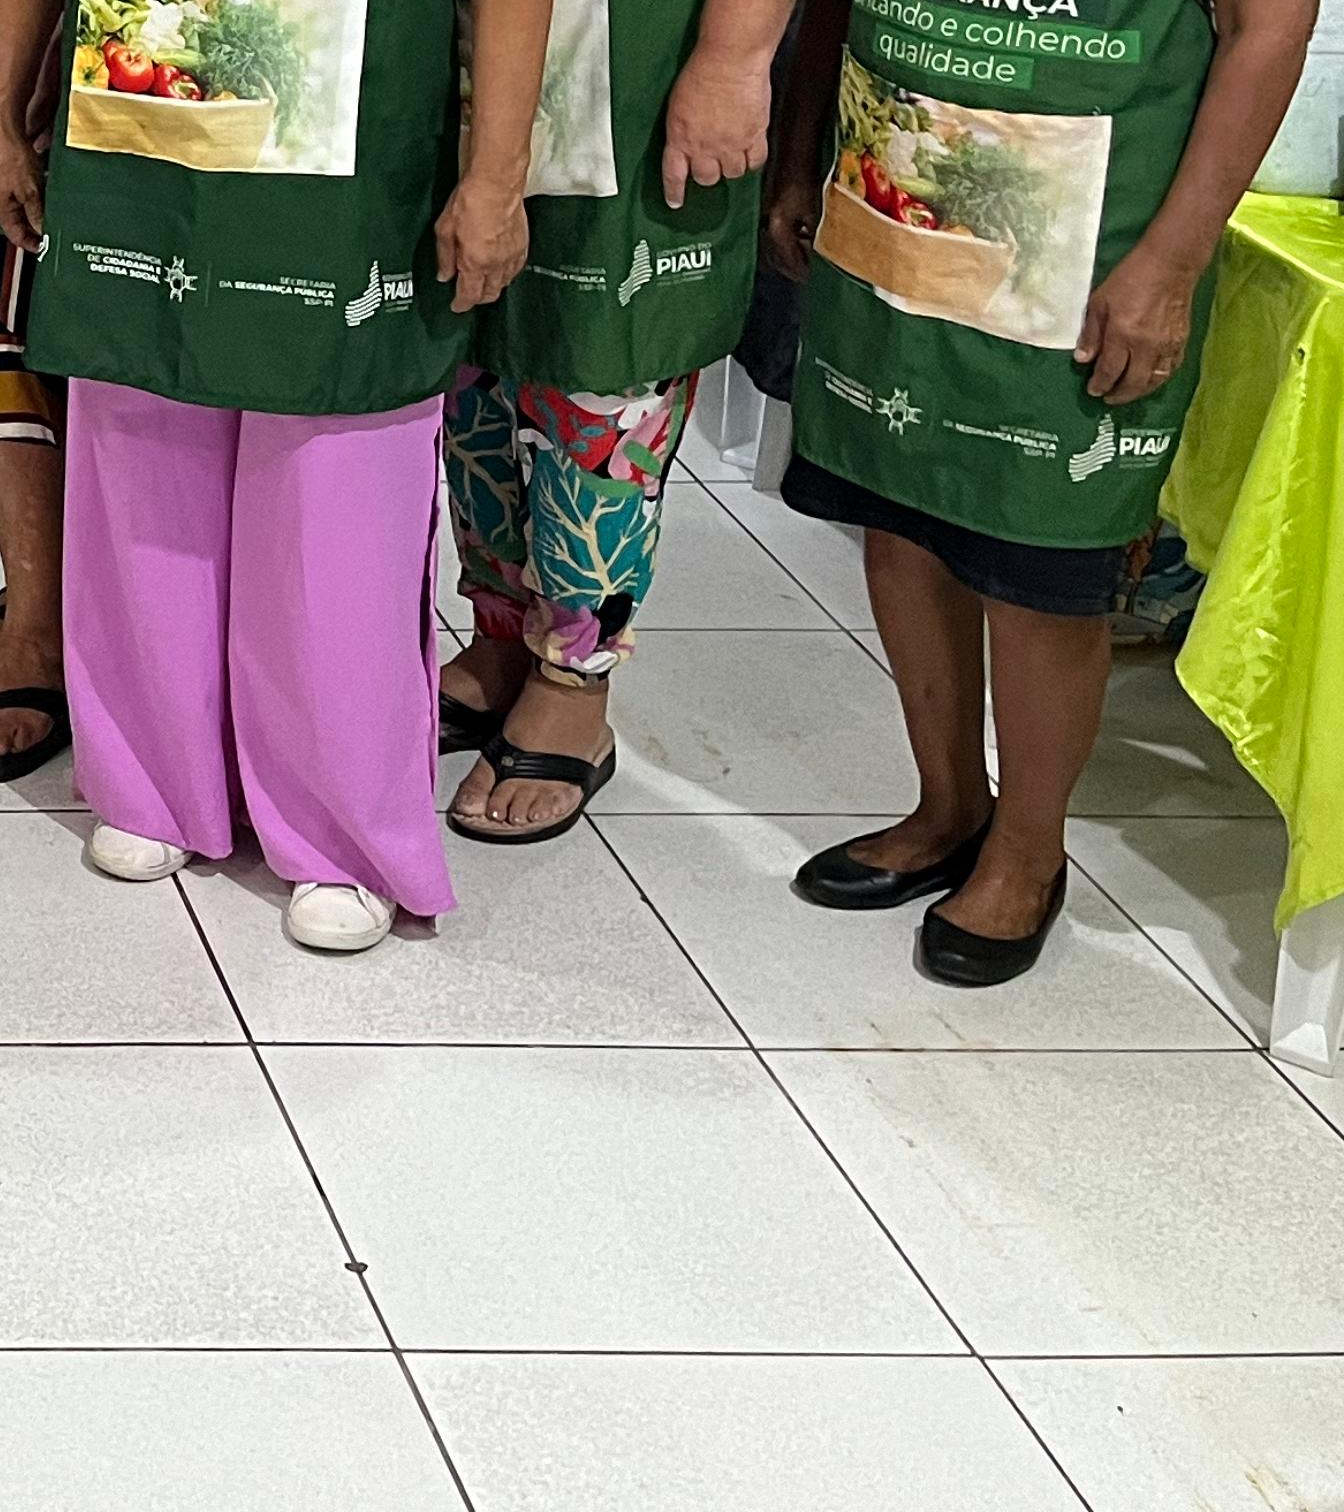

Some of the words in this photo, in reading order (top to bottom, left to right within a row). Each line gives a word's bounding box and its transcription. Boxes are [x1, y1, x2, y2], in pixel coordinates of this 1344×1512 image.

[879, 32, 1017, 83] qualidade
[940, 17, 959, 37] e
[964, 20, 1127, 61] colhendo
